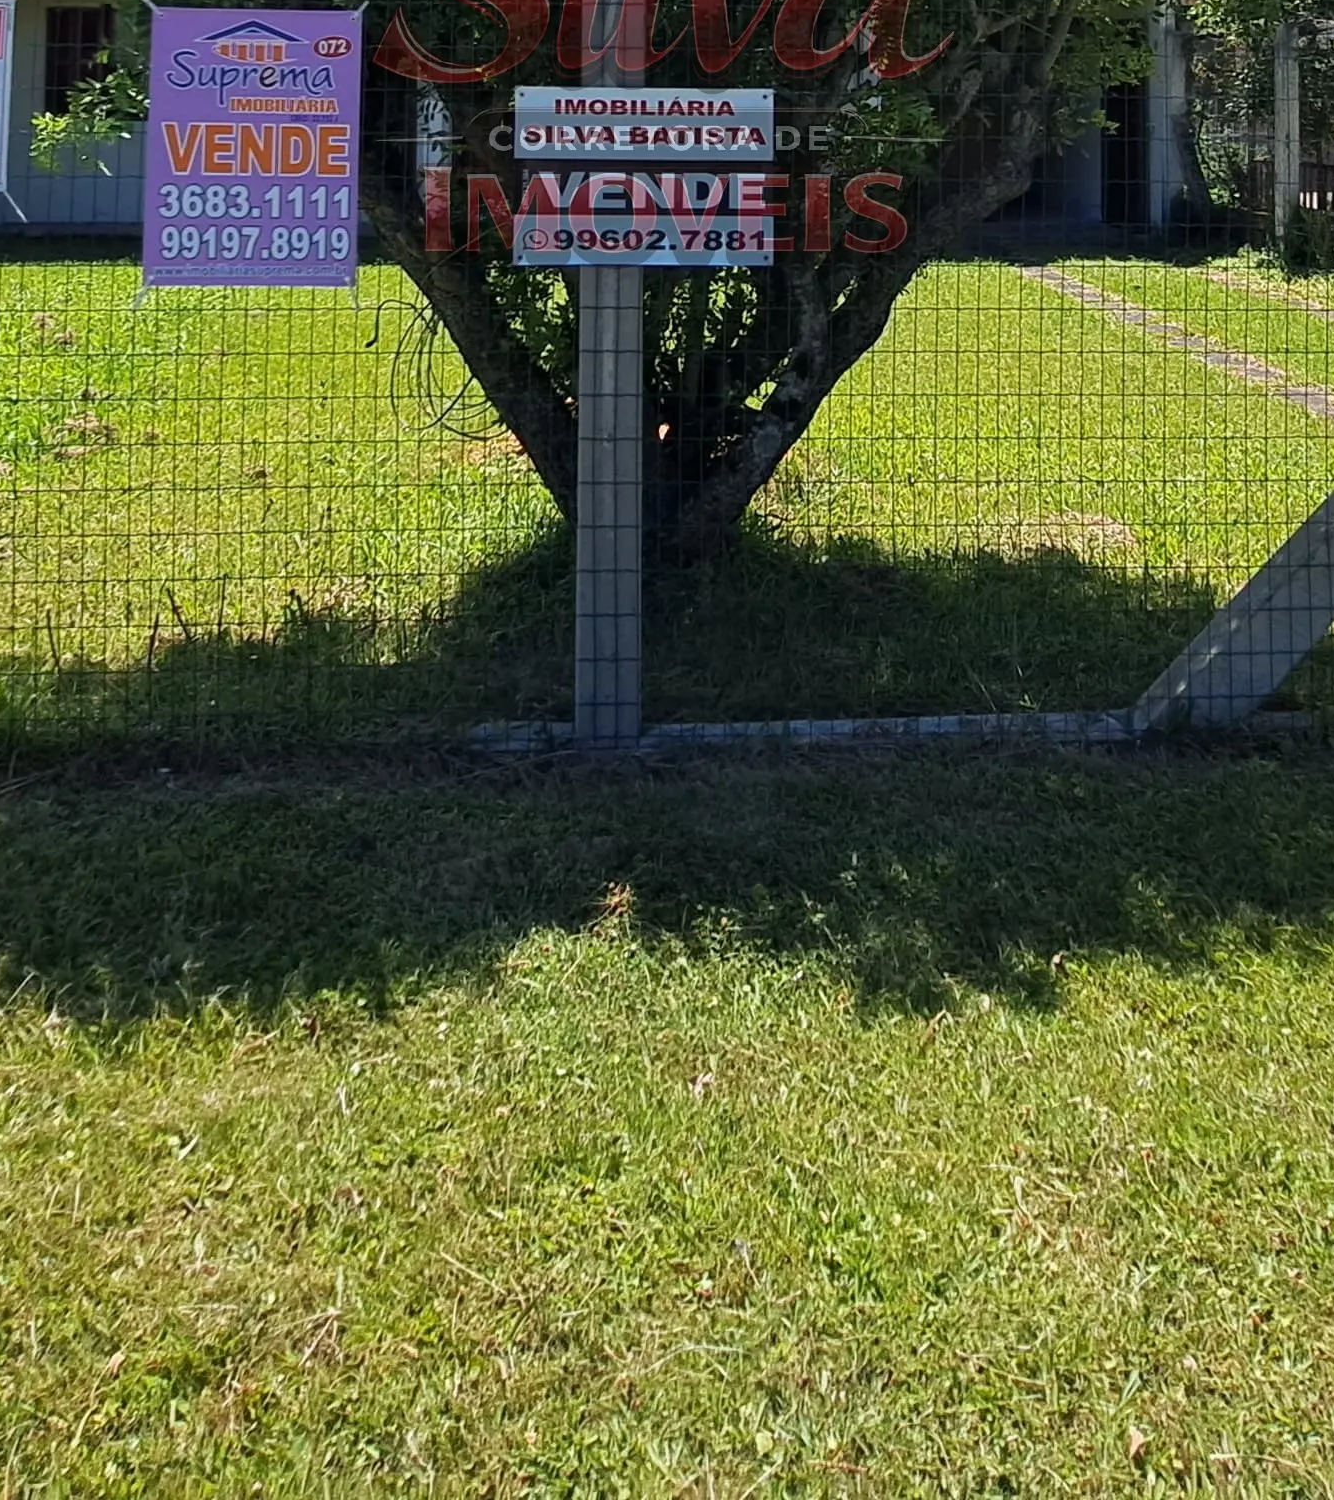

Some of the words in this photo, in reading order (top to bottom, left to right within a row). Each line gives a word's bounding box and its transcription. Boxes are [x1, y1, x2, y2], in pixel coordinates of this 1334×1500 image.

[318, 39, 348, 55] 072
[167, 49, 335, 107] Suprema
[554, 96, 736, 116] IMOBILIÁRIA
[161, 122, 350, 177] VENDE
[523, 125, 617, 145] SILVA
[629, 126, 768, 145] BATISTA
[158, 184, 351, 220] 3683.1111
[538, 171, 766, 209] VENDE
[160, 226, 350, 260] 99197.8919
[553, 229, 765, 251] 99602.7881
